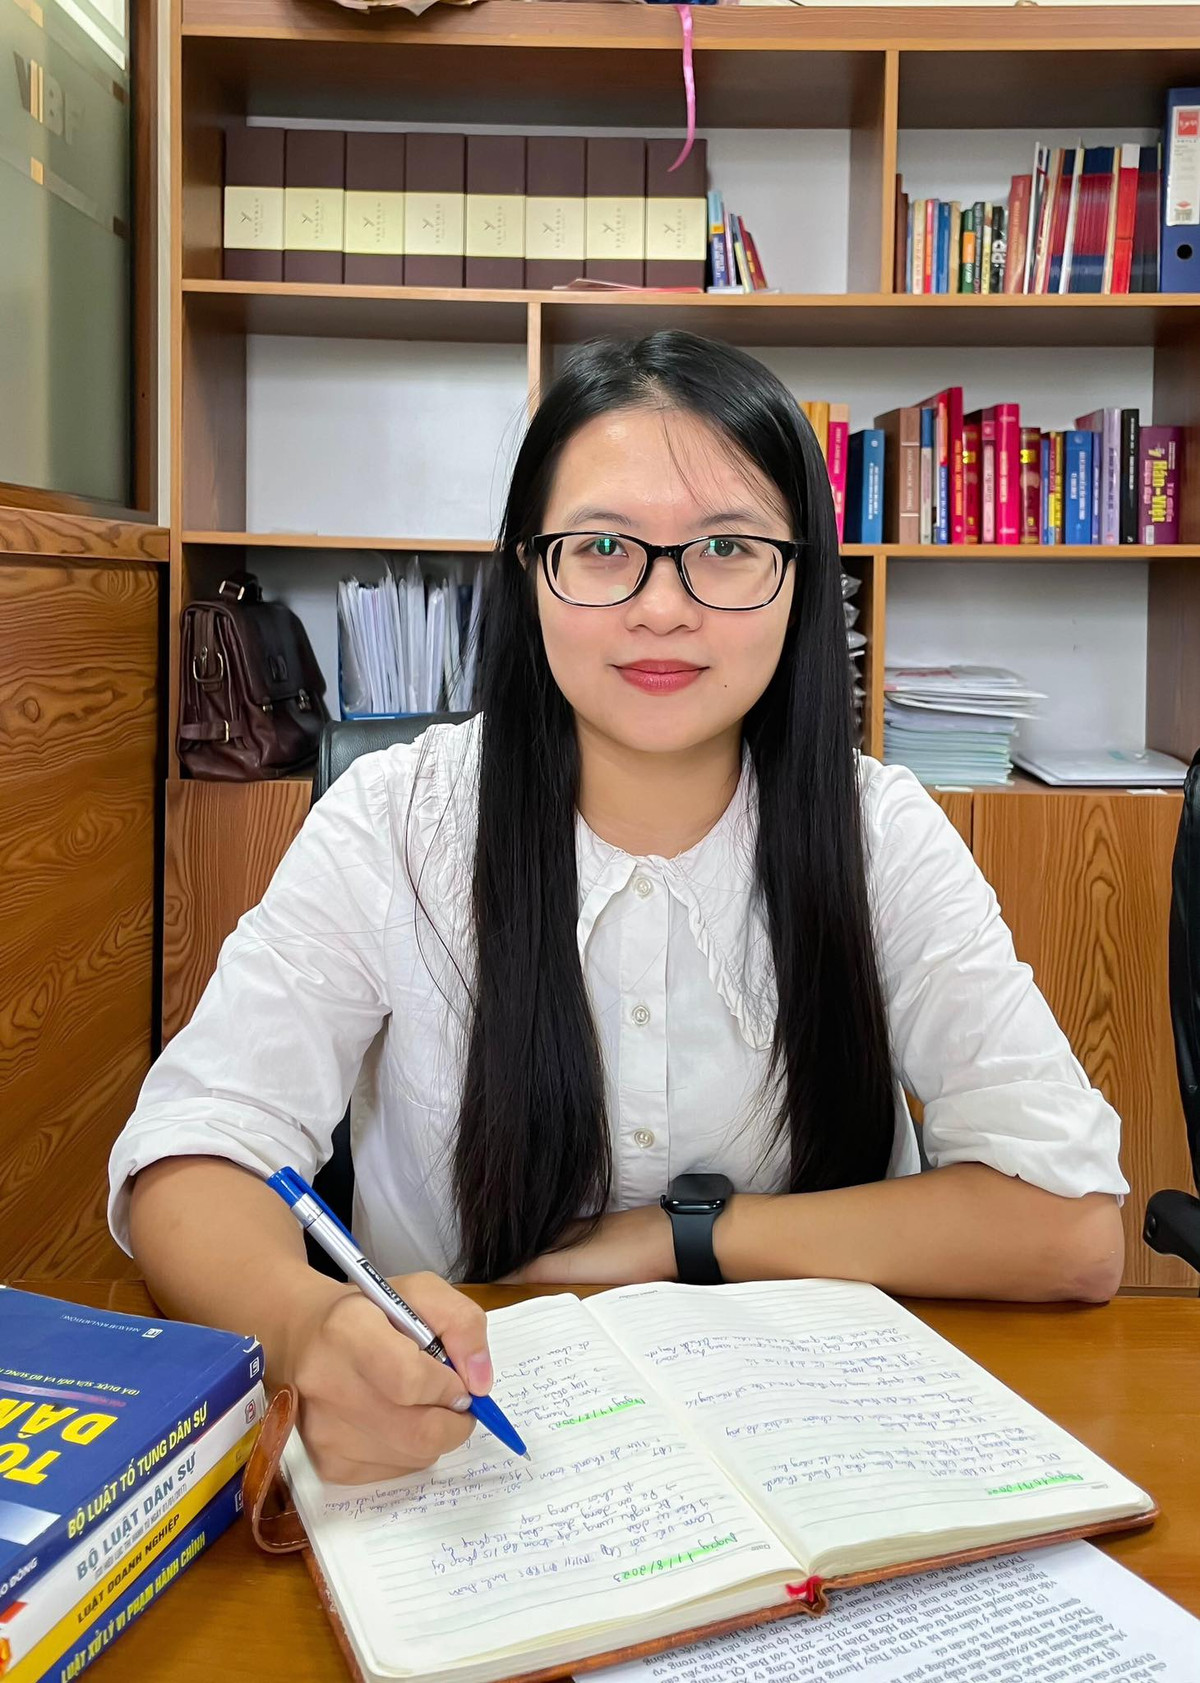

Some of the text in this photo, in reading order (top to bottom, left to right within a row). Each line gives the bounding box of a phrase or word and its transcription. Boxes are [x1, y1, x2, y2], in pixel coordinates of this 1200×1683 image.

[1148, 460, 1168, 522] Hán-Việt
[67, 1401, 207, 1538] BỘ LUẬT TỐ TỤNG DÂN SỰ
[76, 1451, 195, 1580] BỘ LUẬT DÂN SỰ
[77, 1513, 179, 1623] LUẬT DOANH NGHIỆP
[976, 1575, 993, 1585] các
[997, 1579, 1019, 1590] ông
[844, 1570, 939, 1608] do vô hiệu hay tranh
[939, 1588, 958, 1598] cho
[959, 1581, 978, 1593] HĐ
[917, 1595, 940, 1608] thuê
[952, 1593, 983, 1606] Thiên
[1012, 1599, 1033, 1611] Ghi
[60, 1649, 86, 1683] LUẬT
[115, 1610, 126, 1631] VI
[126, 1583, 153, 1620] PHẠM
[154, 1558, 179, 1593] HÀNH
[180, 1531, 205, 1567] CHÍNH
[917, 1603, 954, 1618] Thanh,
[943, 1604, 982, 1621] nhượng
[680, 1565, 989, 1678] An được ký kết là tự nguyện, không bị ép buộc và không yêu
[850, 1618, 873, 1630] năm
[896, 1613, 918, 1625] ông
[1038, 1618, 1055, 1629] An
[824, 1626, 852, 1641] 2012
[915, 1622, 934, 1632] các
[651, 1618, 807, 1676] các hợp đồng nêu trên trong vụ
[788, 1640, 815, 1654] 2021
[878, 1635, 897, 1646] cho
[678, 1644, 701, 1654] việc
[815, 1642, 843, 1656] Linh
[860, 1642, 880, 1655] SN
[642, 1650, 678, 1666] không
[745, 1657, 769, 1669] Ban
[768, 1651, 787, 1662] với
[795, 1653, 815, 1665] với
[725, 1666, 745, 1677] QL
[764, 1660, 795, 1675] Công
[797, 1665, 814, 1675] An
[824, 1661, 864, 1679] Hương
[753, 1670, 765, 1680] ty
